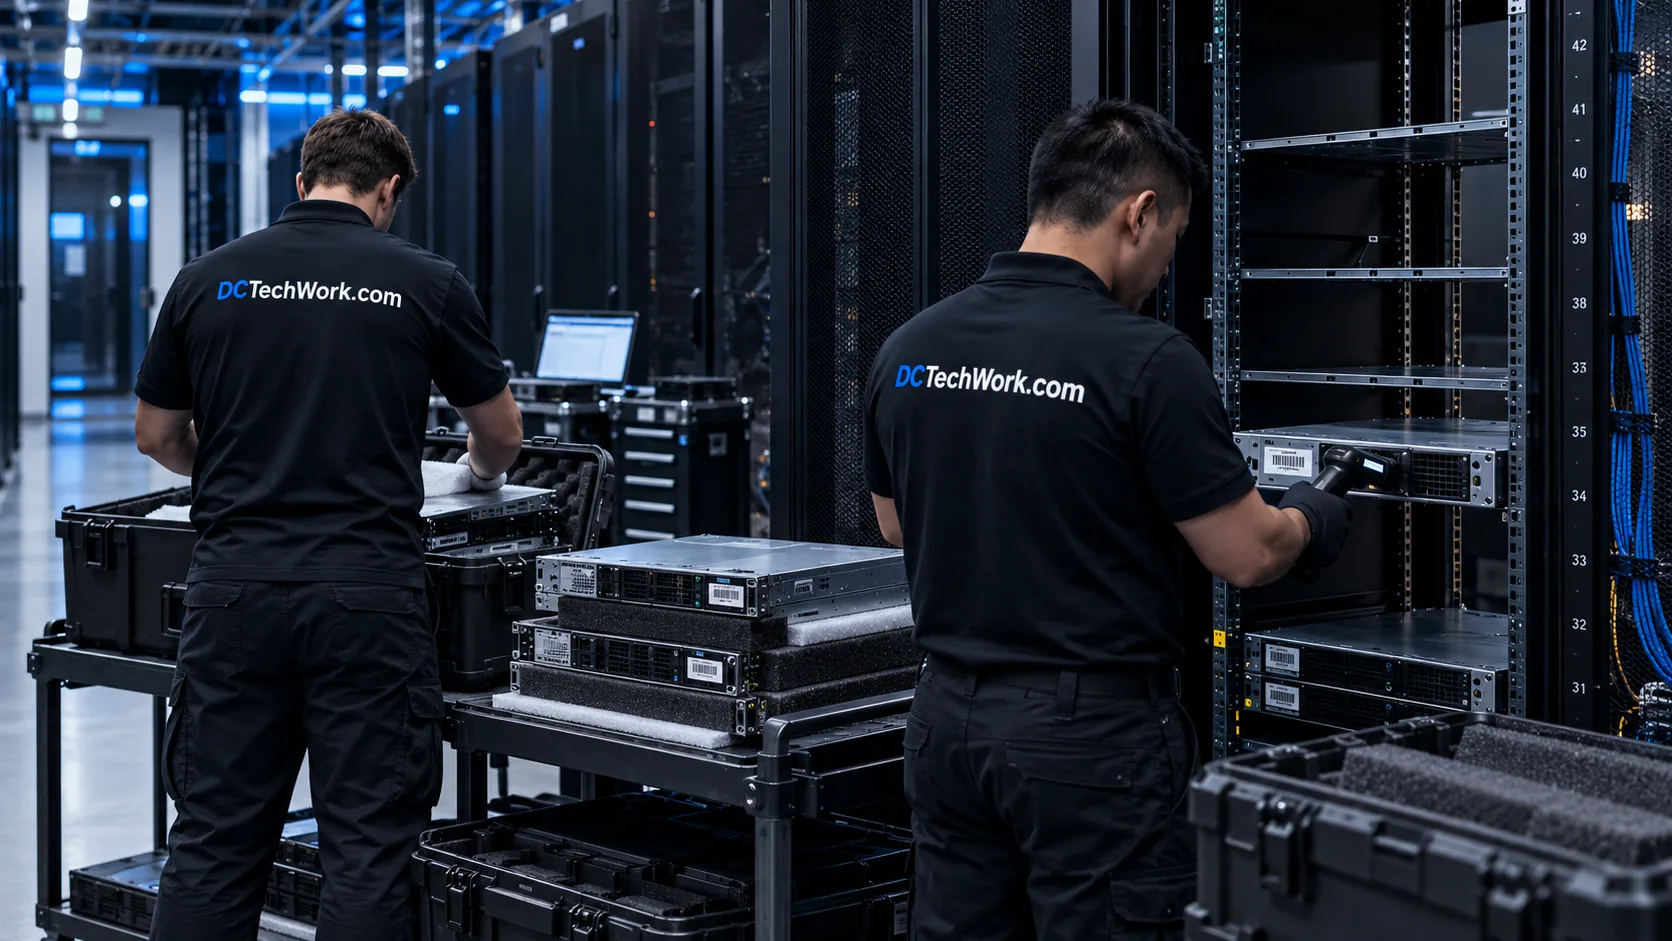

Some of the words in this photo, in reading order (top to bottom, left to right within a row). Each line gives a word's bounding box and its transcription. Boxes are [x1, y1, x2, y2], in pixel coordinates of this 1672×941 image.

[1572, 39, 1587, 52] 42
[1572, 103, 1586, 115] 41
[1572, 167, 1587, 179] 40
[1572, 232, 1587, 244] 39
[217, 280, 402, 308] DCTechWork.com
[1572, 297, 1587, 309] 38
[895, 364, 1085, 404] DCTechWork.com
[1572, 426, 1587, 438] 35
[1572, 490, 1587, 502] 34
[1572, 554, 1587, 567] 33
[1572, 618, 1587, 631] 32
[1572, 682, 1586, 695] 31
